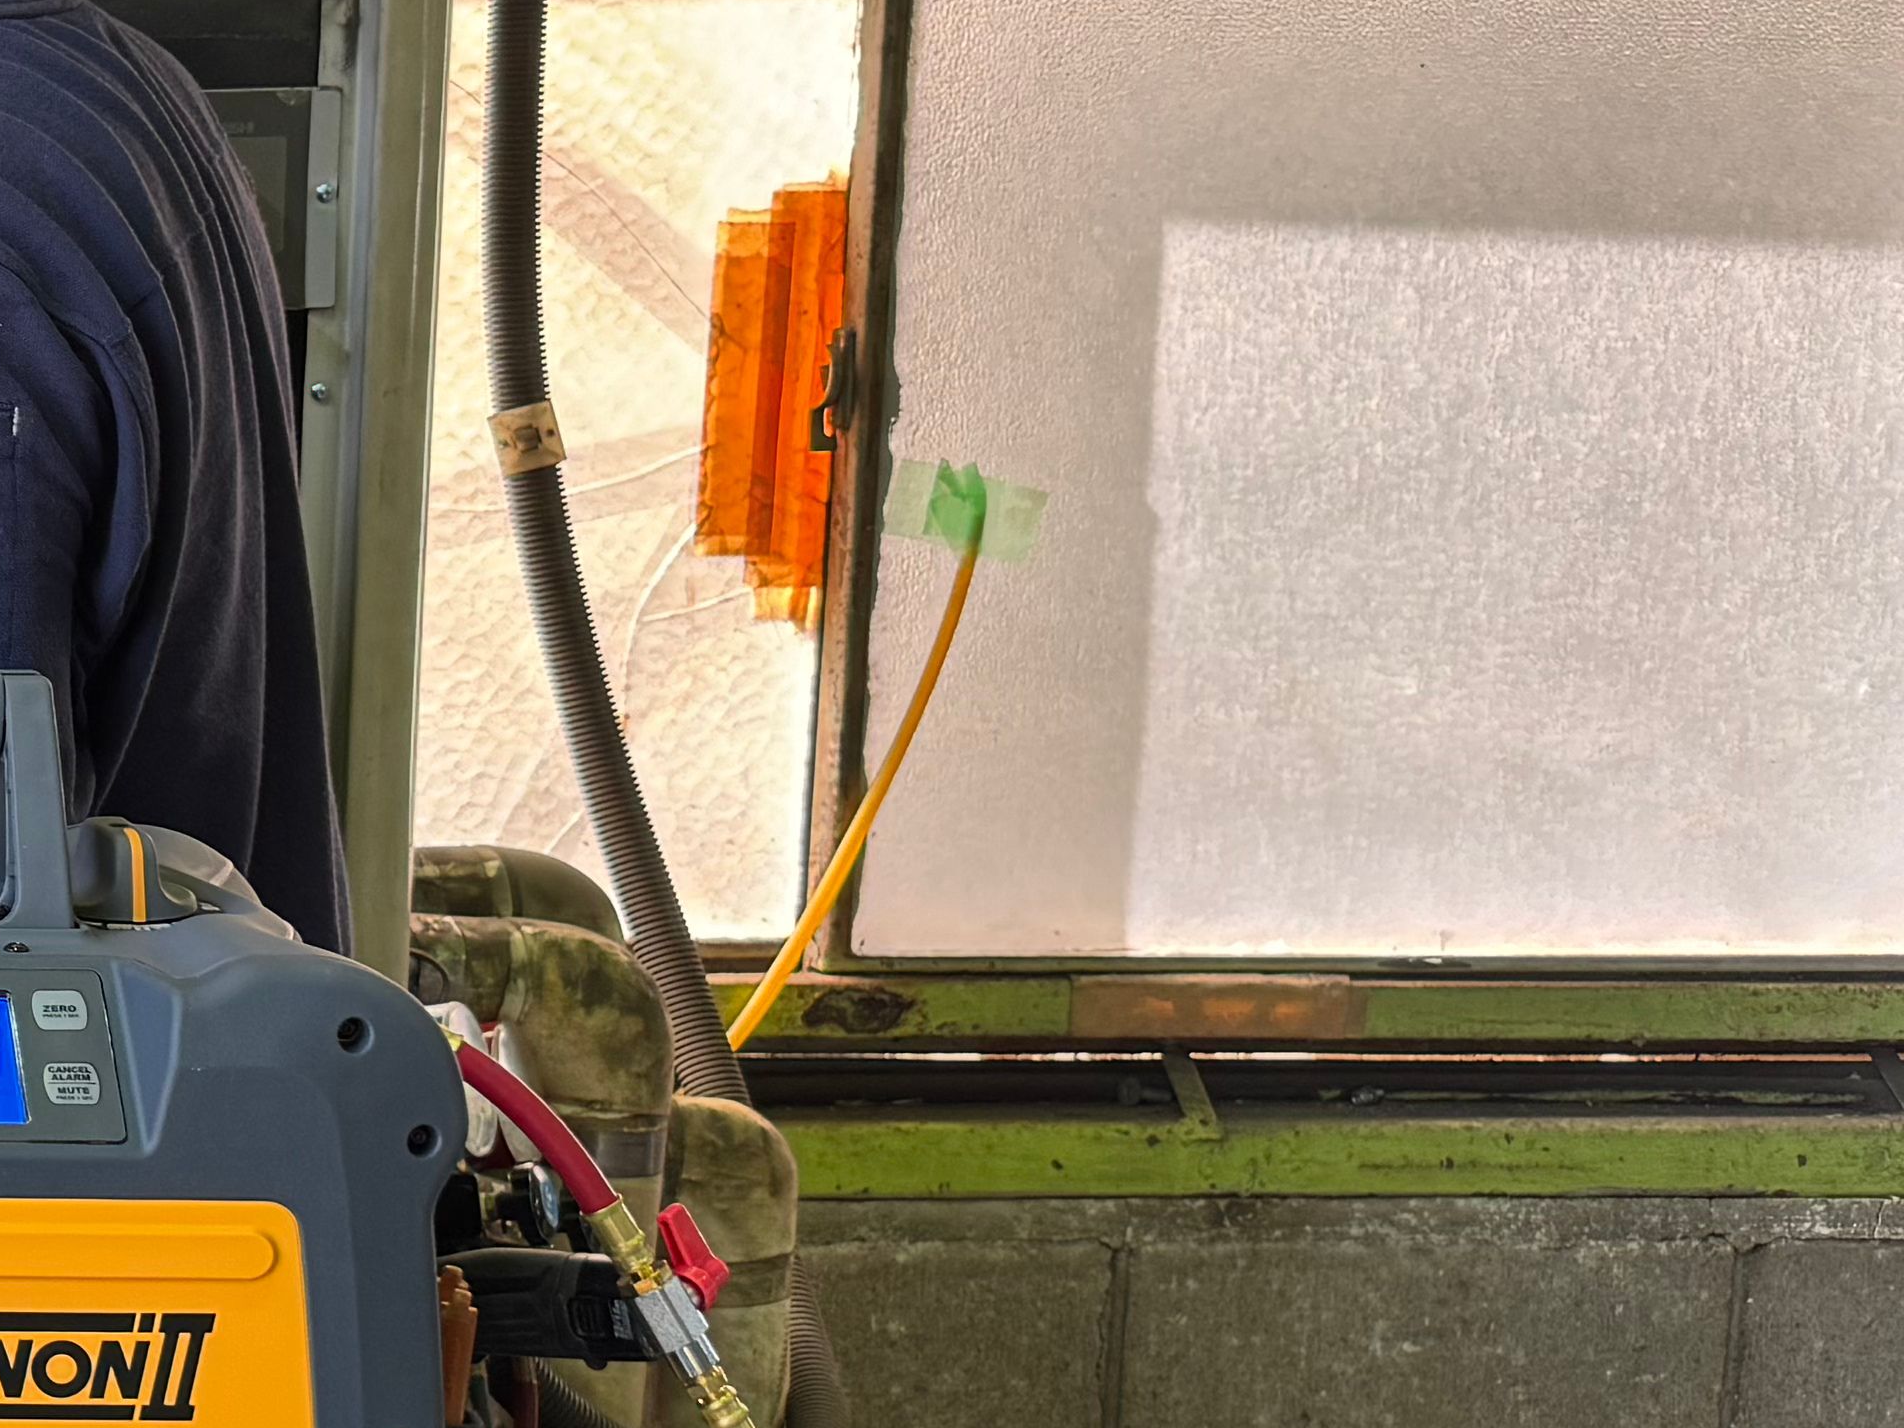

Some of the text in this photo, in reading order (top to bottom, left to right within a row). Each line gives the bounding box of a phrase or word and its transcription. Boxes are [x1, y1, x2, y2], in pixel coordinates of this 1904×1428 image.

[42, 1004, 78, 1013] ZERO
[47, 1065, 92, 1074] CANCEL
[50, 1073, 91, 1082] ALARM
[57, 1086, 90, 1095] MUTE
